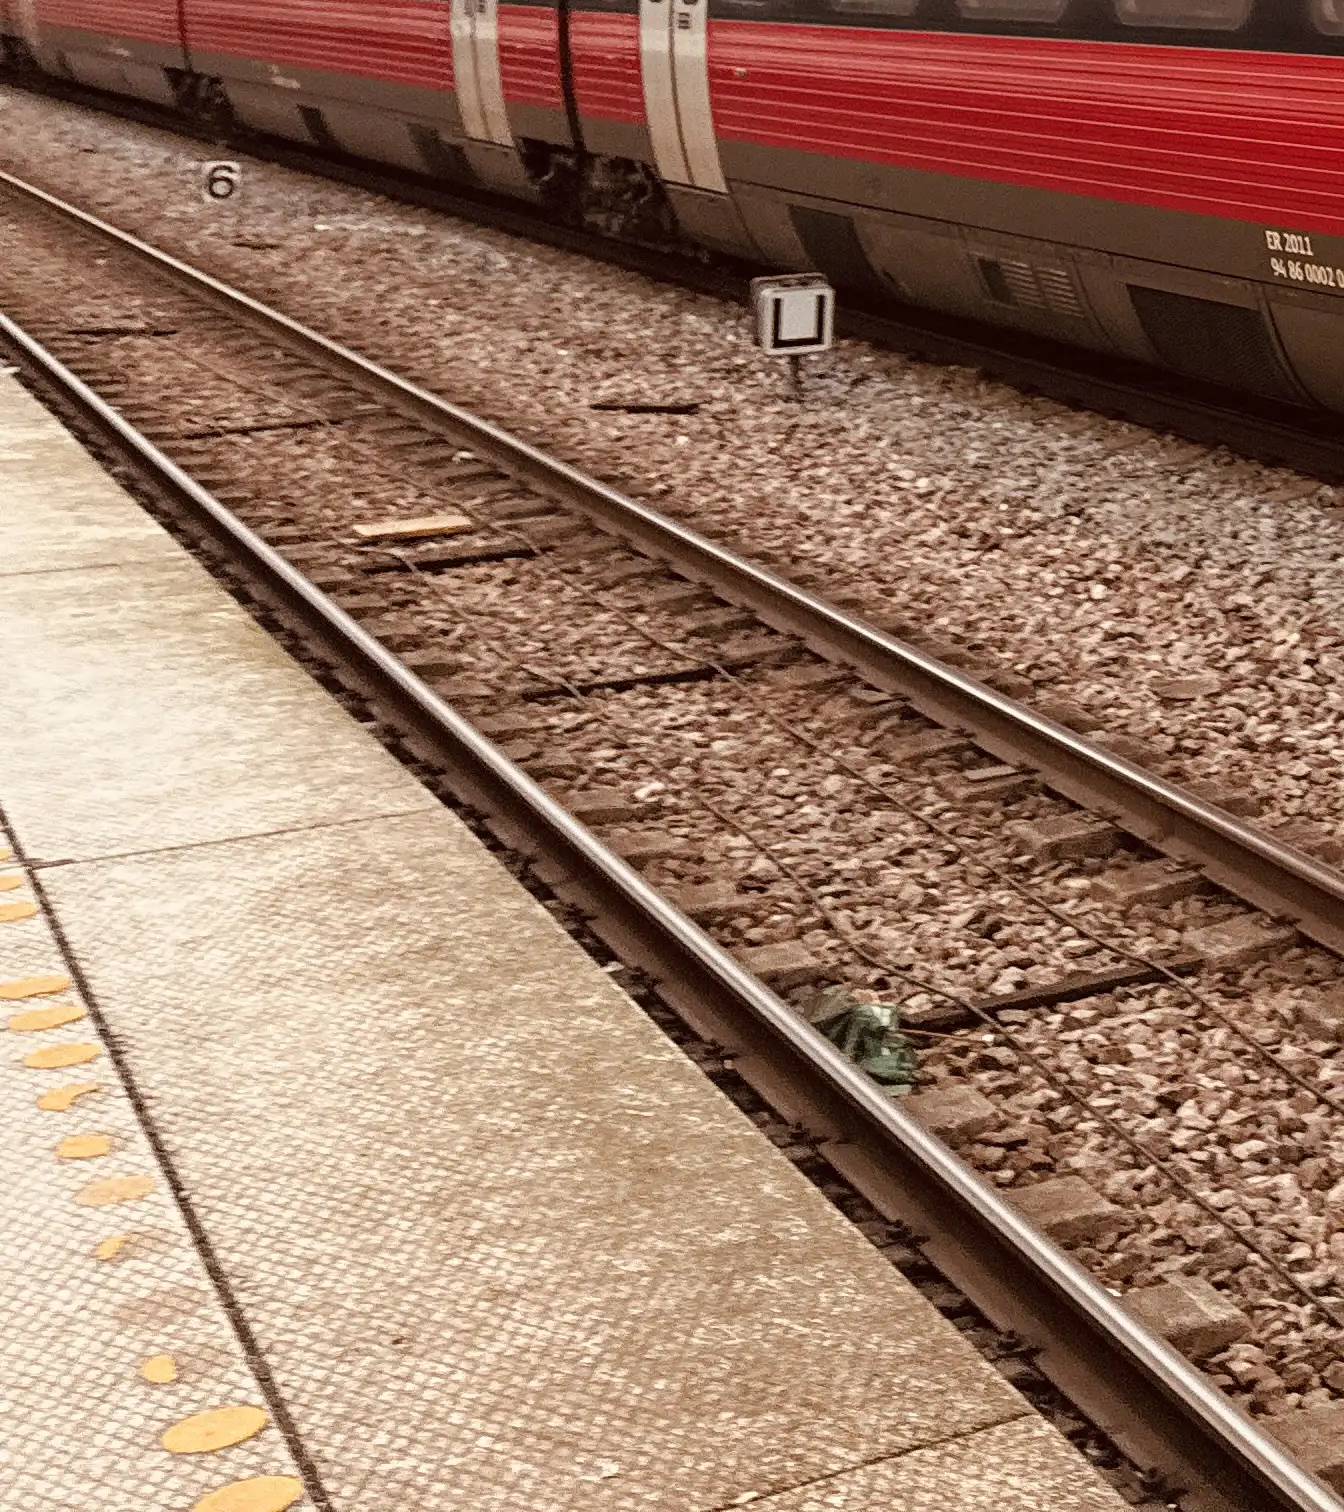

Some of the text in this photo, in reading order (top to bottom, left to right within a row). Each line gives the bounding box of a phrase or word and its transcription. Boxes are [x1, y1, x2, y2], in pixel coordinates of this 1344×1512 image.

[208, 164, 238, 199] 6
[1265, 230, 1314, 256] ER 2011
[1270, 257, 1288, 278] 94
[1288, 260, 1304, 281] 86
[1304, 263, 1335, 287] 0002
